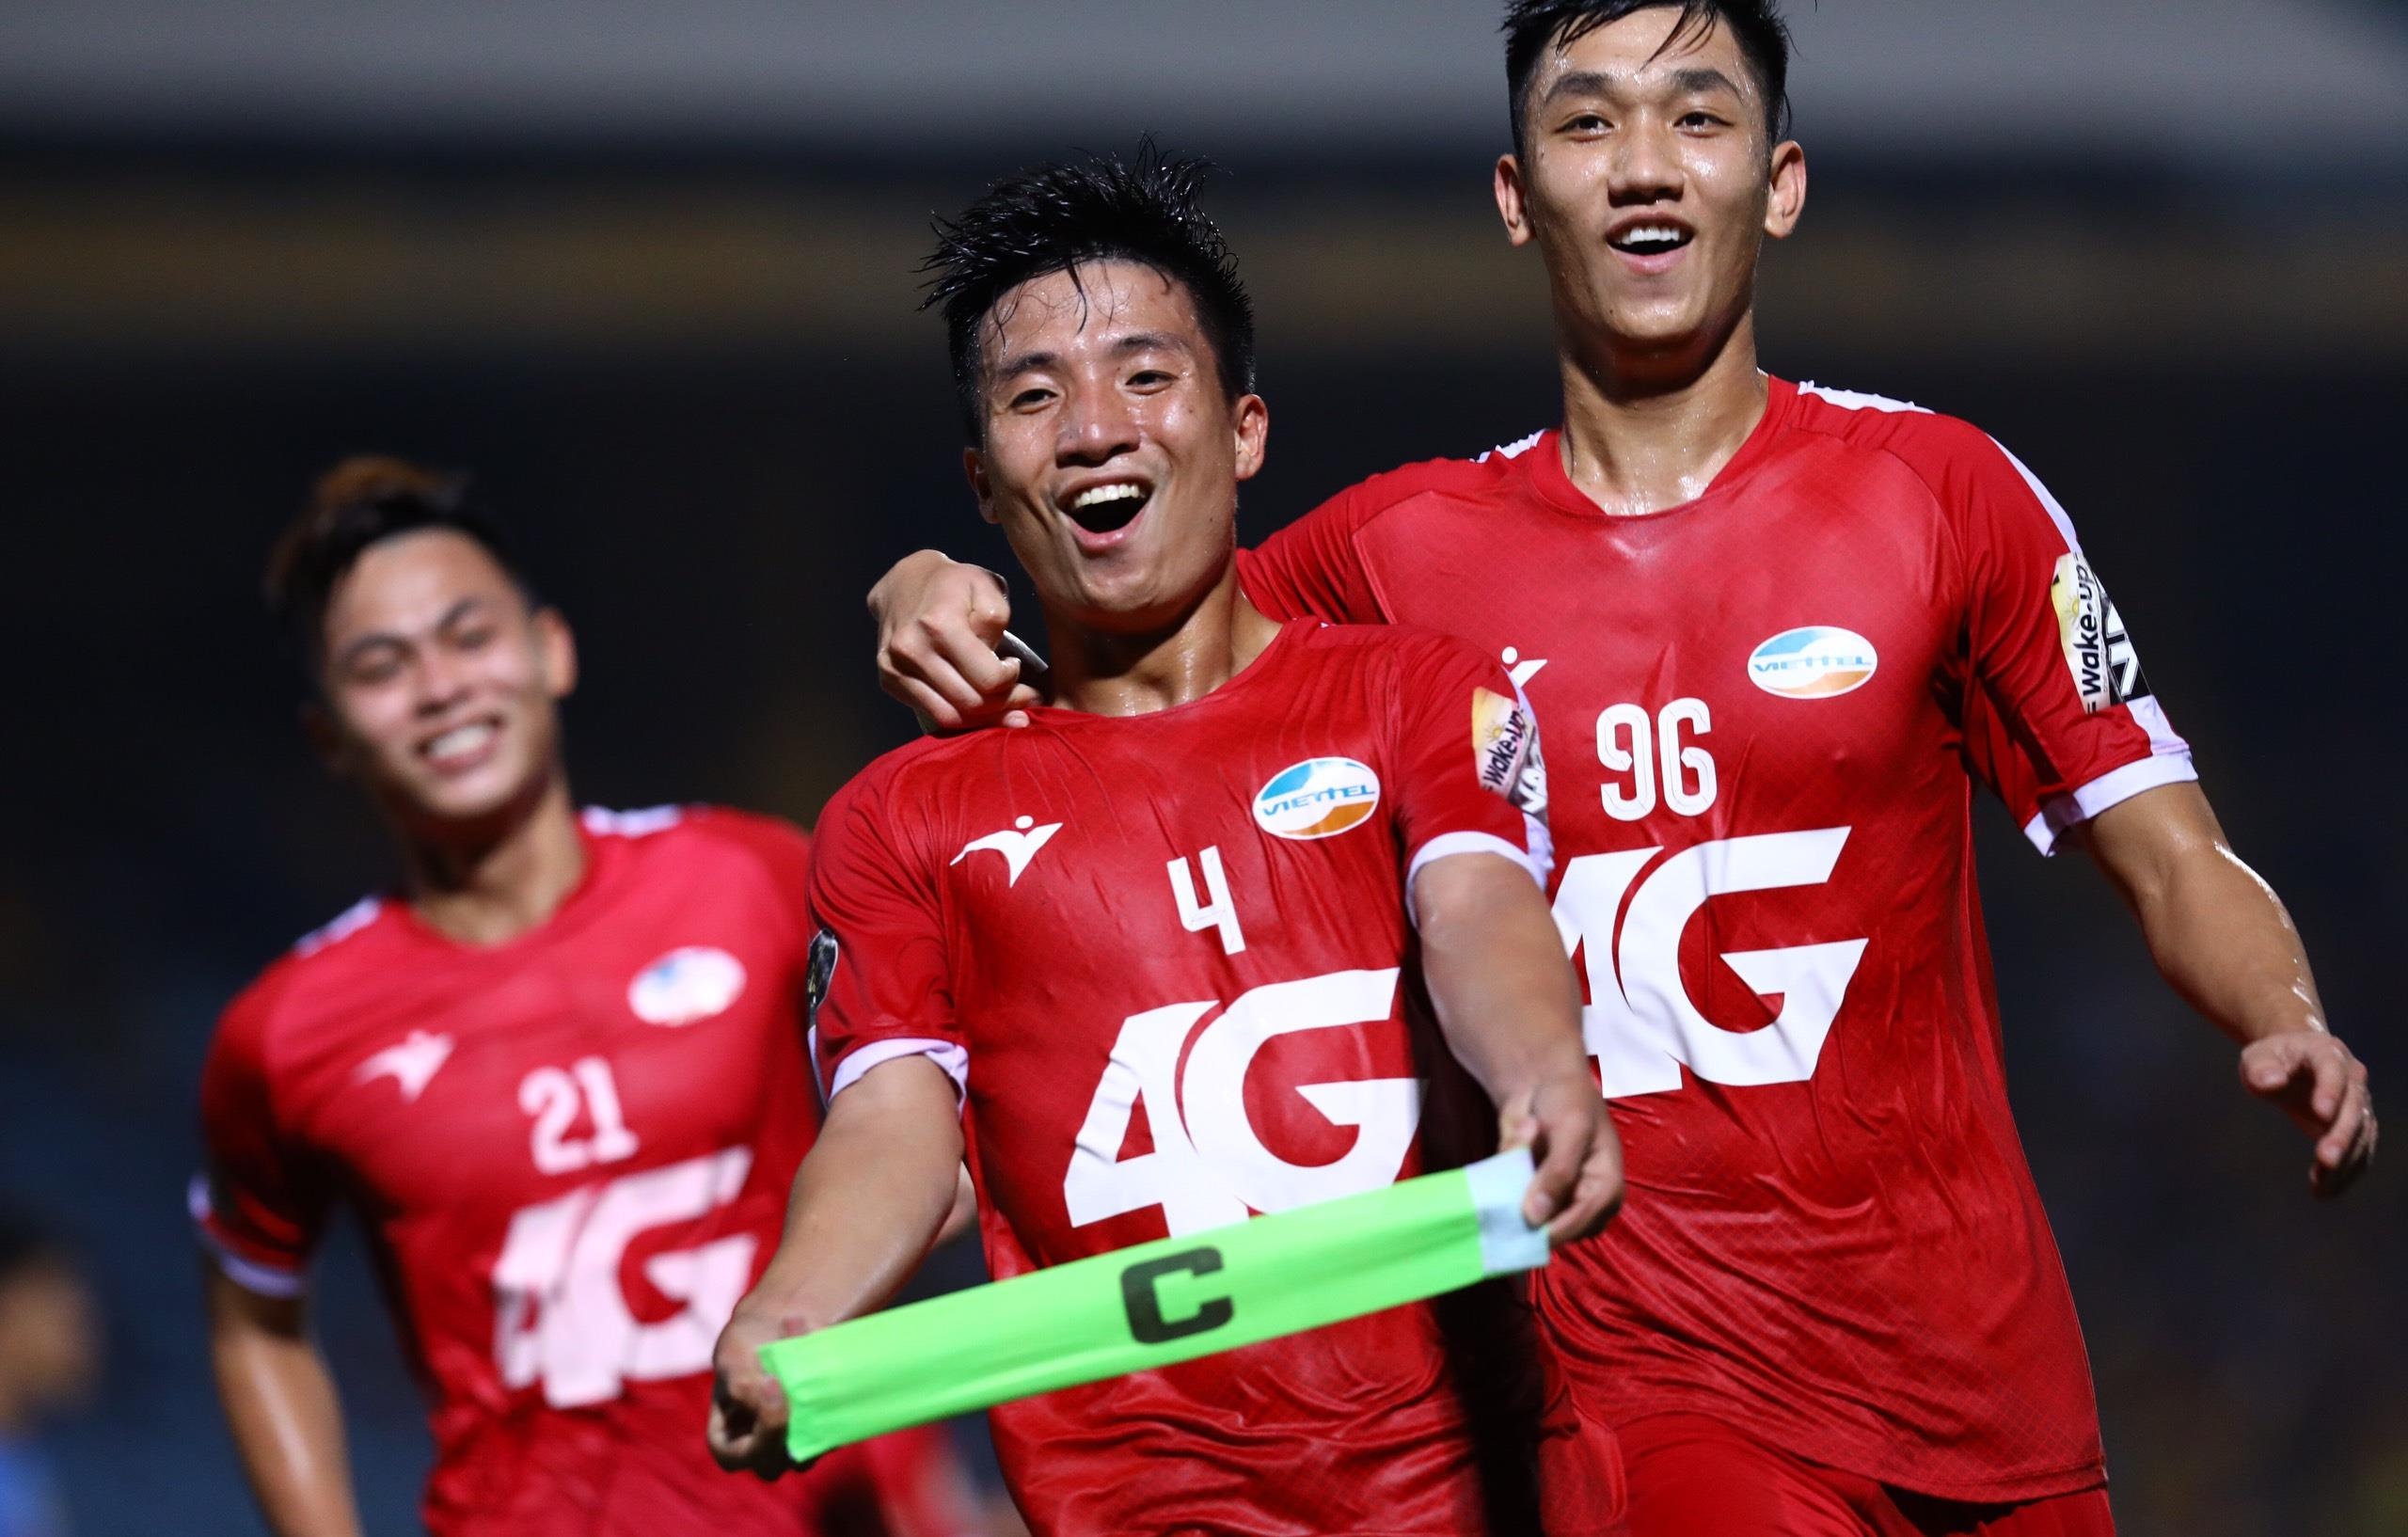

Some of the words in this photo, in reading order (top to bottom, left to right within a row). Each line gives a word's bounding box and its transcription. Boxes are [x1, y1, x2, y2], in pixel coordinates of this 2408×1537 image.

[2073, 564, 2101, 696] wake-up
[1263, 784, 1376, 816] VIETTEL
[1595, 697, 1719, 822] 96
[1166, 845, 1246, 956] 4
[1550, 825, 1870, 1100] 4G
[518, 1055, 641, 1176] 21
[1063, 967, 1430, 1240] 4G
[493, 1144, 760, 1410] 4G
[1119, 1246, 1235, 1345] C
